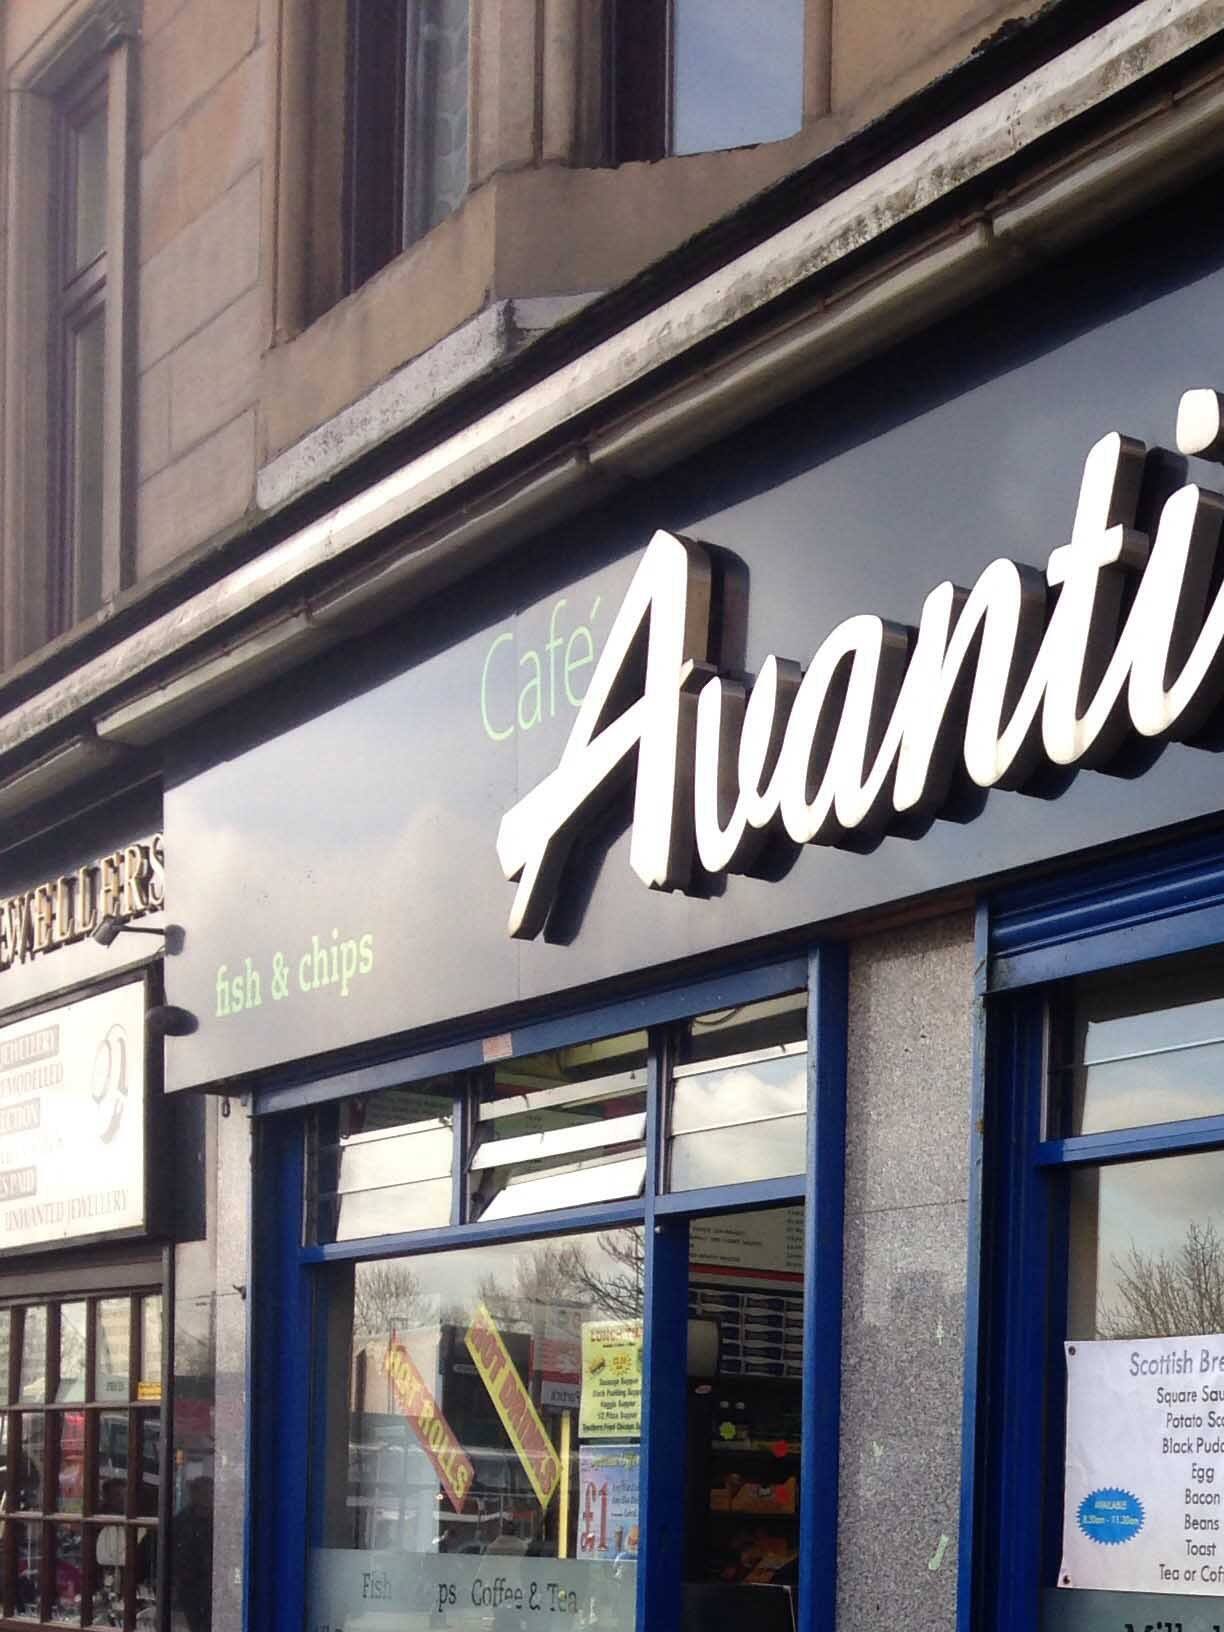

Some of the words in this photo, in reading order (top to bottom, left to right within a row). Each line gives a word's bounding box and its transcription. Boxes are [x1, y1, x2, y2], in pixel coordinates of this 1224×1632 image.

[481, 597, 601, 741] Café
[215, 957, 262, 1017] fish
[272, 951, 290, 1001] &
[299, 928, 374, 998] chips
[1129, 1348, 1194, 1377] Scottish
[1156, 1387, 1198, 1407] Square
[1166, 1413, 1203, 1428] Potato
[1162, 1438, 1194, 1456] Black
[1191, 1464, 1215, 1484] Egg
[1184, 1488, 1221, 1505] Bacon
[1184, 1514, 1220, 1531] Beans
[1186, 1540, 1217, 1557] Toast
[1159, 1564, 1180, 1581] Tea
[1184, 1568, 1196, 1582] or
[471, 1576, 524, 1610] Coffee
[528, 1581, 541, 1611] &
